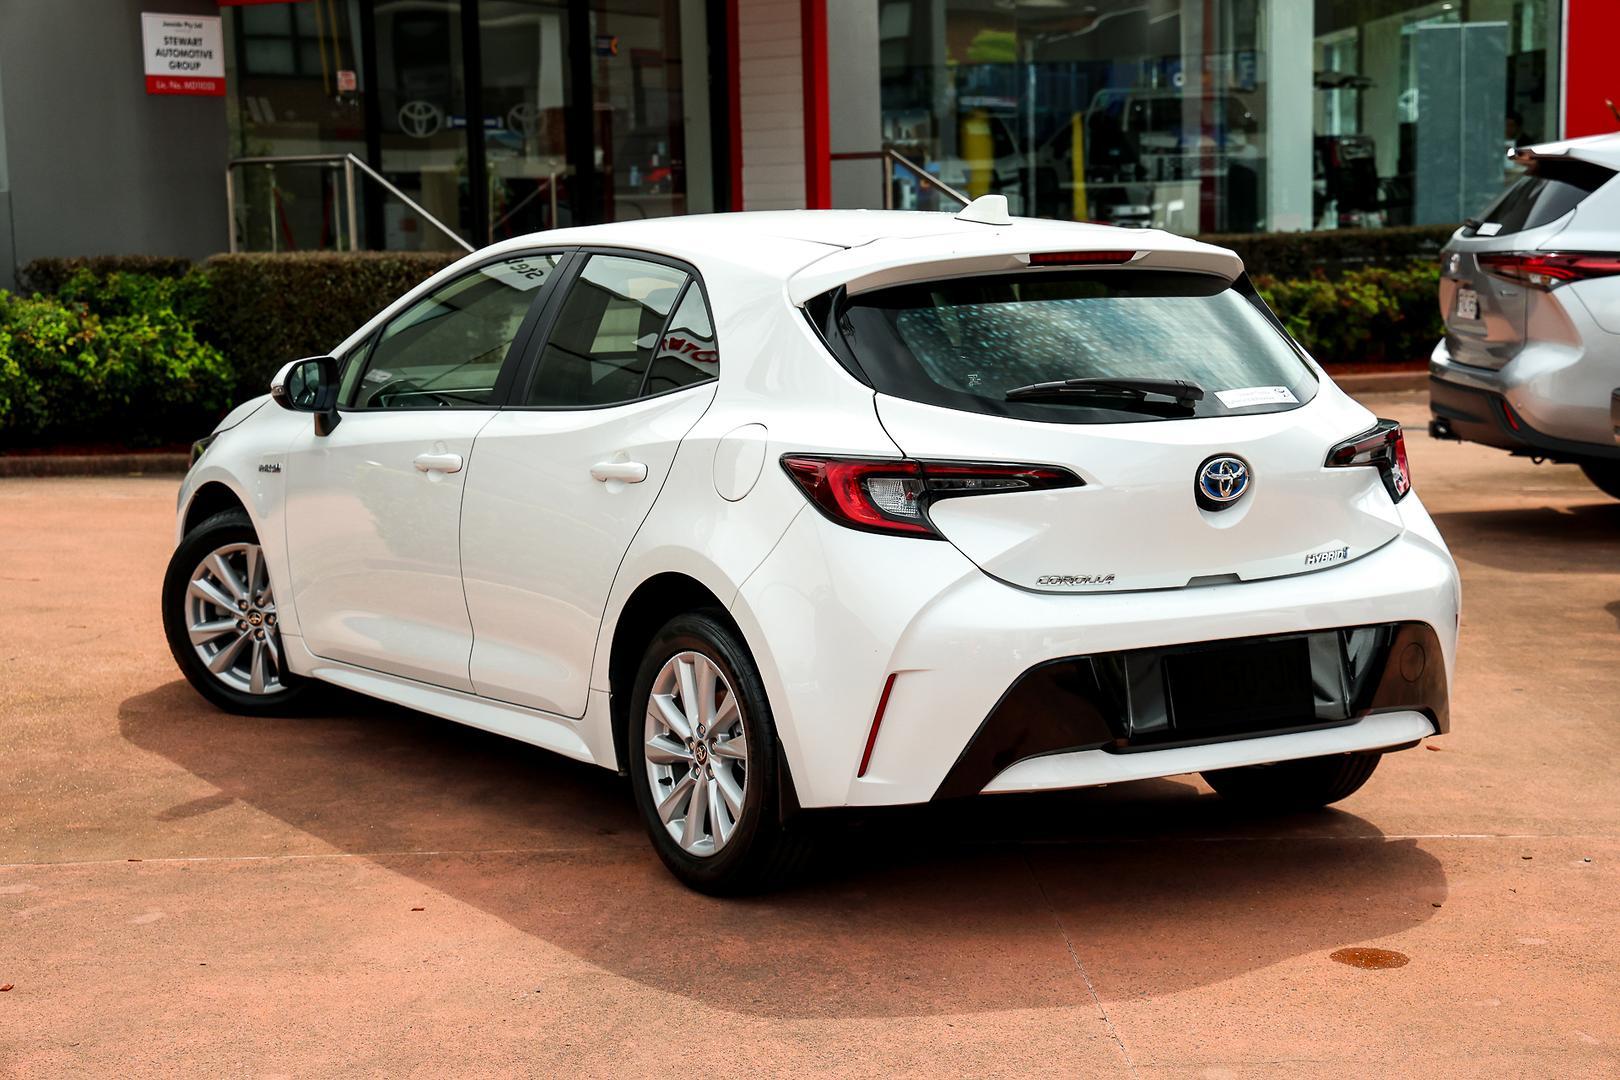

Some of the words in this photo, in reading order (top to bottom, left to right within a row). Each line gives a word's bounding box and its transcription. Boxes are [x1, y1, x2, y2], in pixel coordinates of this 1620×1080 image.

[164, 36, 203, 46] STEWART
[155, 48, 212, 59] AUTOMOTIVE
[169, 61, 201, 70] GROUP
[1304, 548, 1343, 565] HYBRID
[1036, 574, 1115, 587] COROLLA
